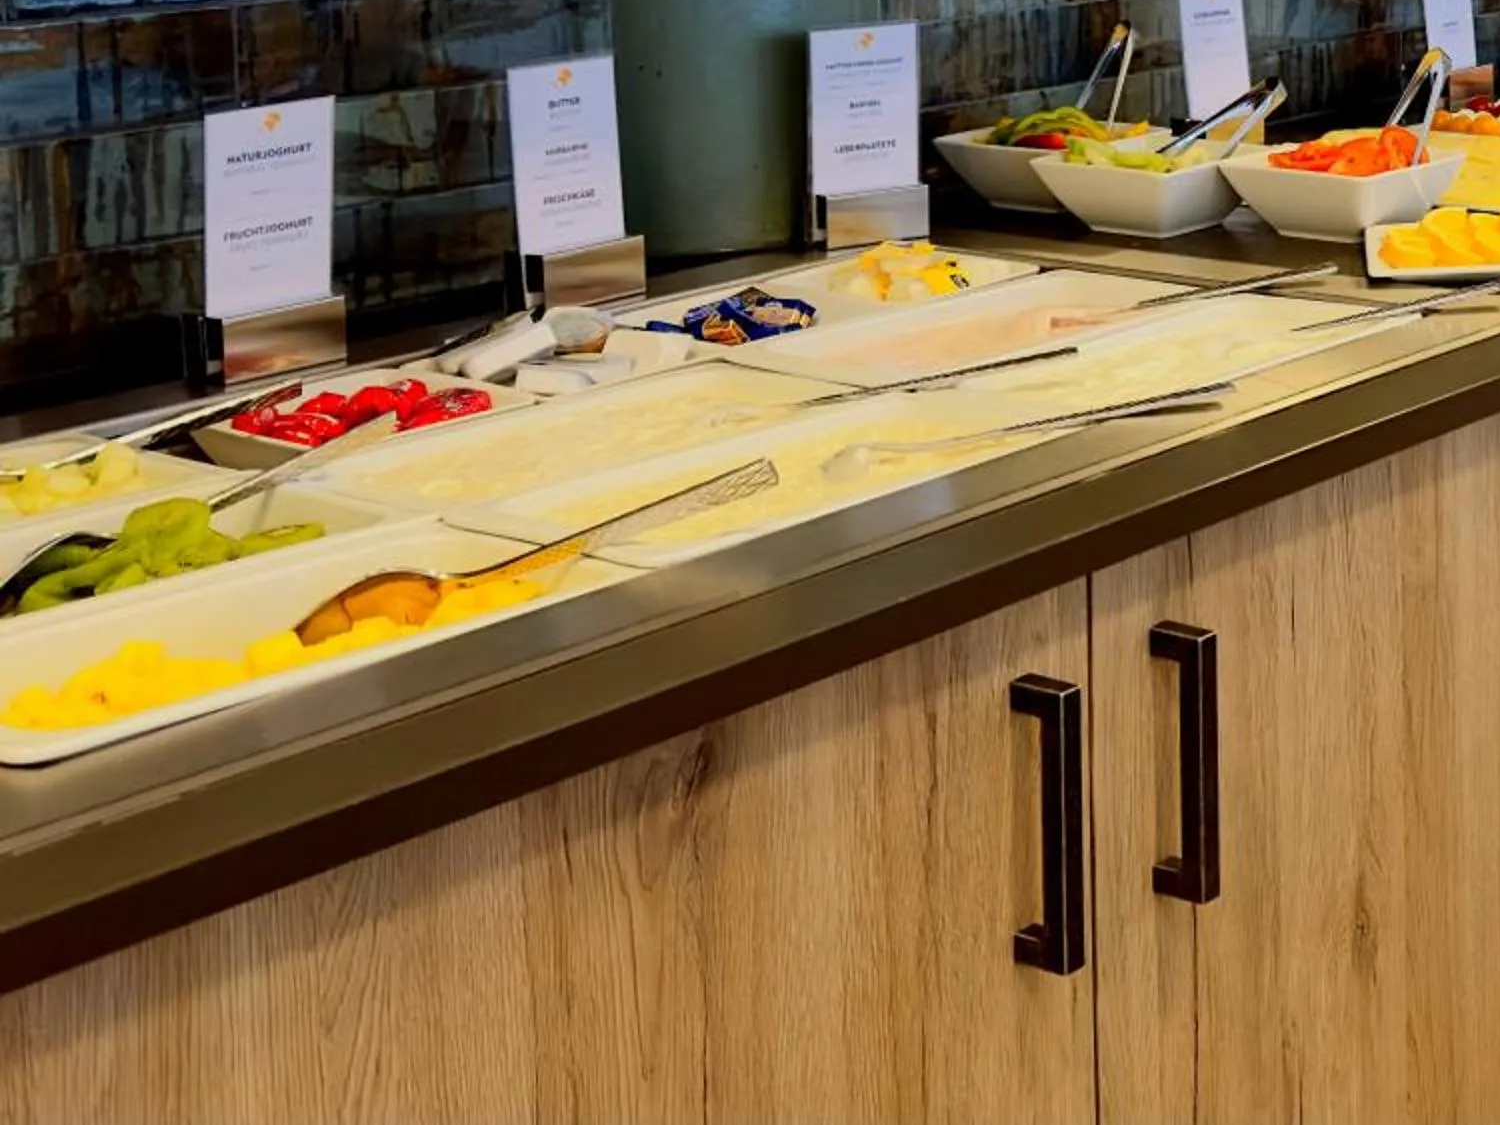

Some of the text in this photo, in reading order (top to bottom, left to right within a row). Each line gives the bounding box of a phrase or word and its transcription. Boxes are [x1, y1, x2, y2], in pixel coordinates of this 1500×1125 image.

[548, 96, 581, 110] BUTTER
[226, 142, 313, 165] NATURJOGHURT
[223, 216, 314, 242] FRUCHTJOGHURT
